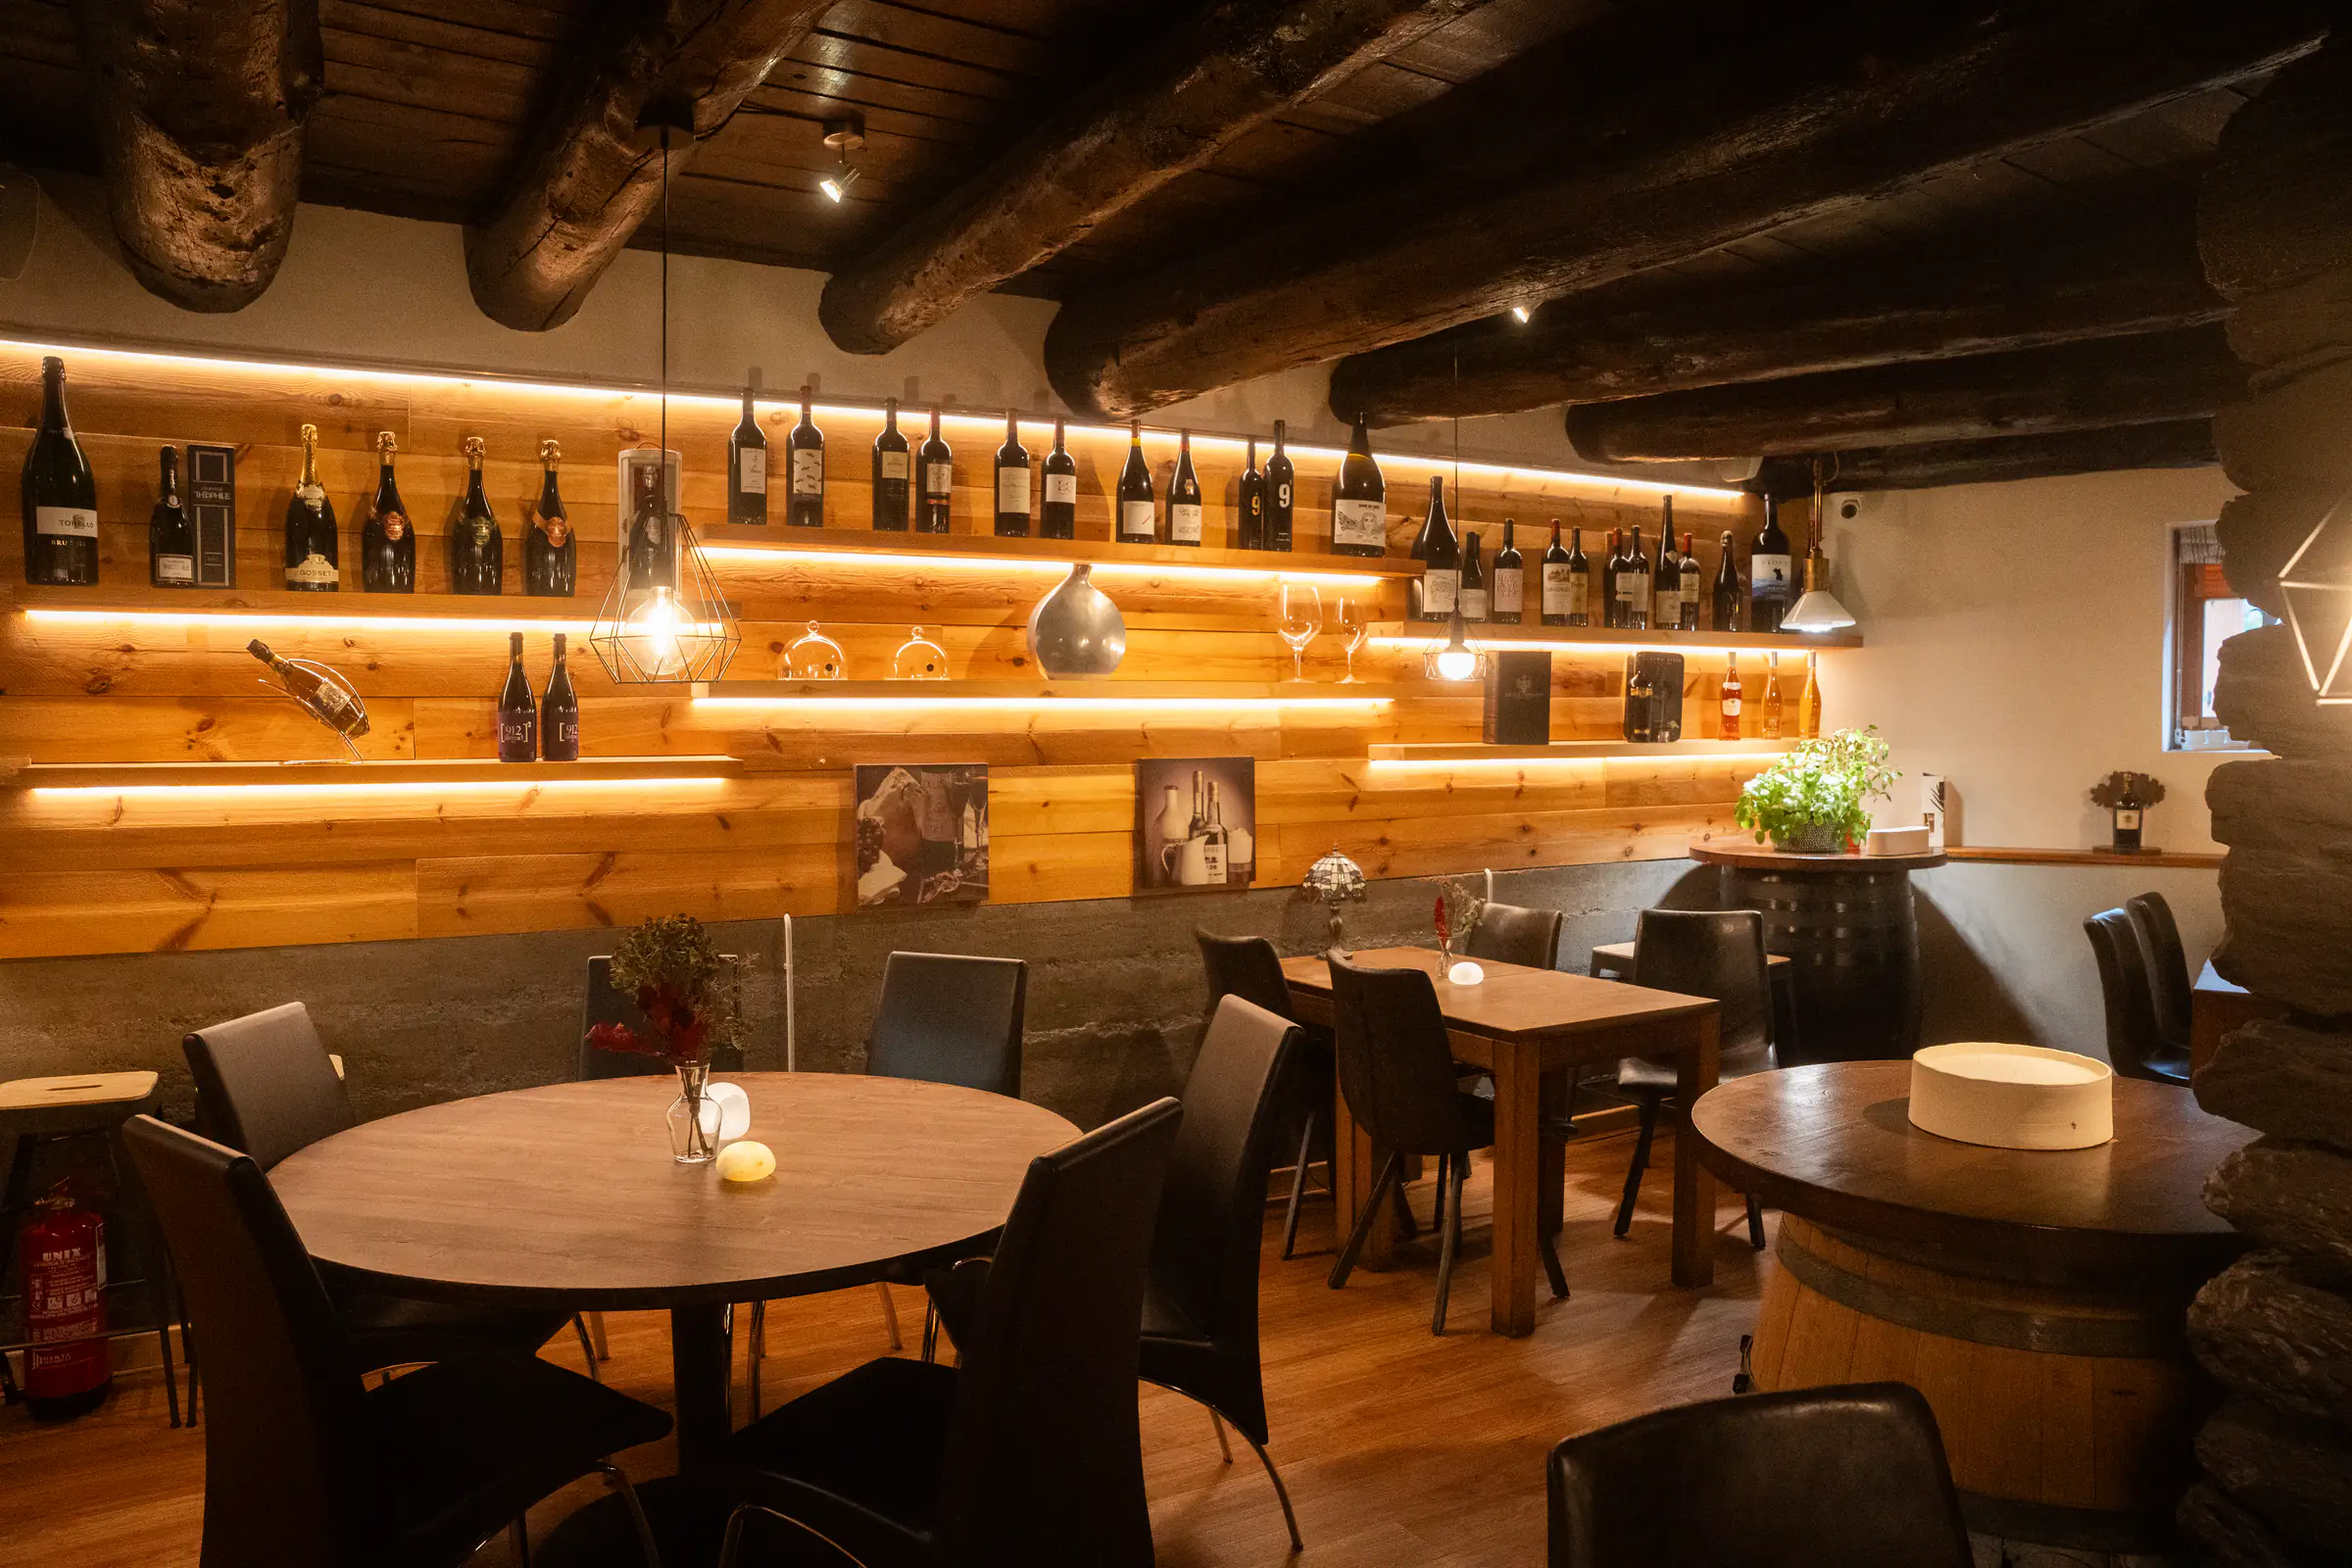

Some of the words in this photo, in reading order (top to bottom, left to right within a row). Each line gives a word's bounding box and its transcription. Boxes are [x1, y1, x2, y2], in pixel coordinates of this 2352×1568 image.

[1251, 495, 1260, 515] 9
[1279, 483, 1291, 508] 9
[42, 1247, 81, 1260] UNIX
